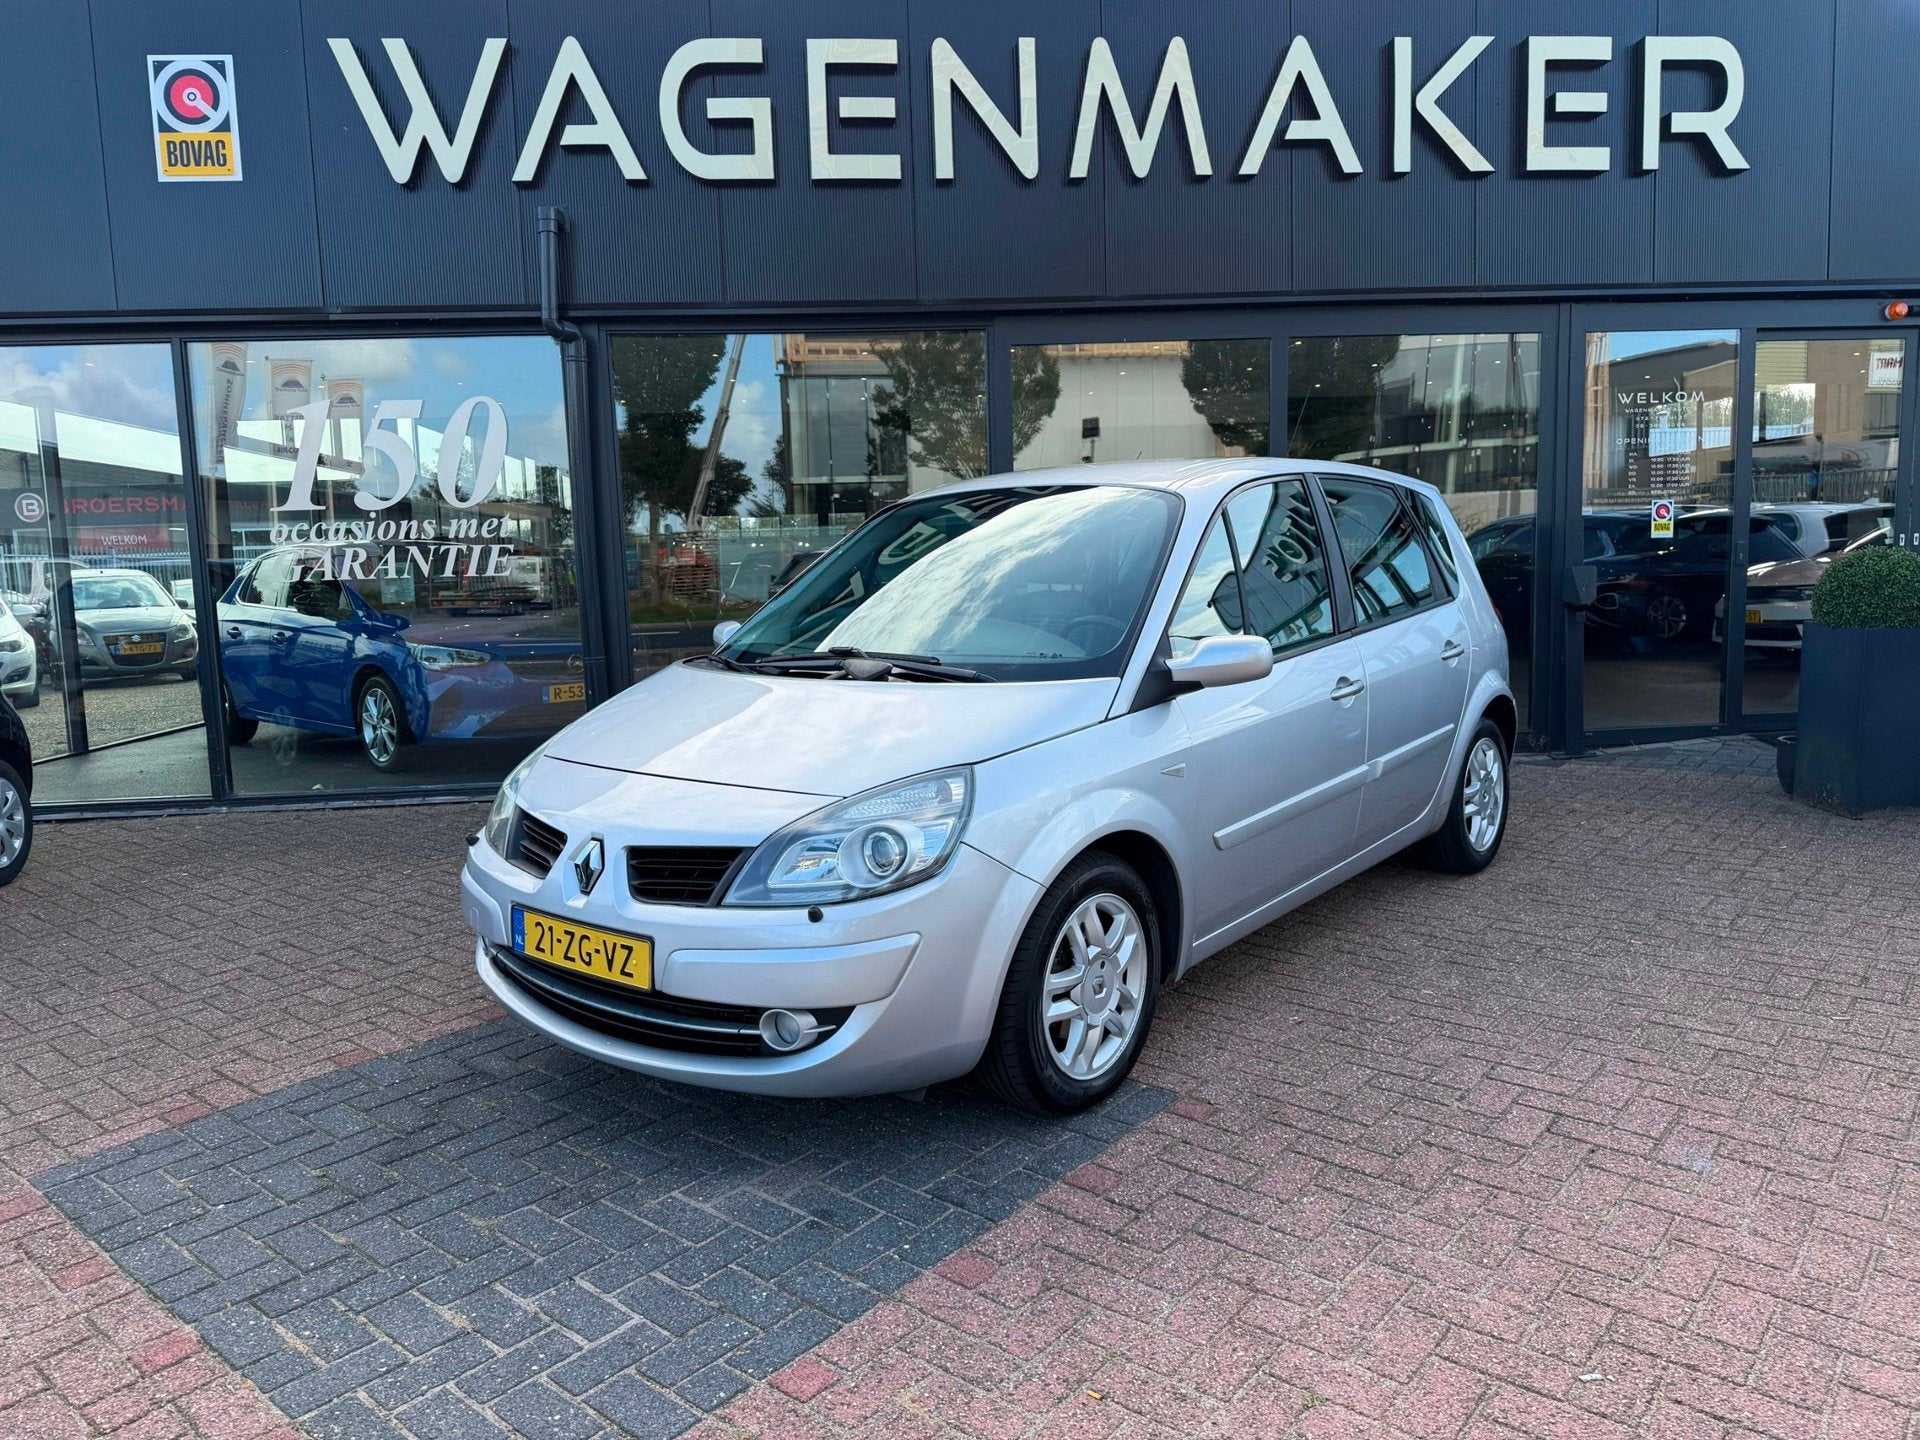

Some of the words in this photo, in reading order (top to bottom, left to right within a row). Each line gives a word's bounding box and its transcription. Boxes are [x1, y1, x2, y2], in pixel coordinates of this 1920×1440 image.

[326, 34, 1751, 185] WAGENMAKER
[166, 139, 227, 168] BOVAG
[1617, 391, 1705, 404] WELKOM
[271, 395, 508, 512] 150
[101, 534, 147, 546] WELKOM
[269, 511, 436, 544] occasions
[448, 512, 511, 539] met
[277, 543, 514, 582] GARANTIE
[515, 933, 524, 945] NL
[534, 921, 634, 978] 21-ZG-VZ
